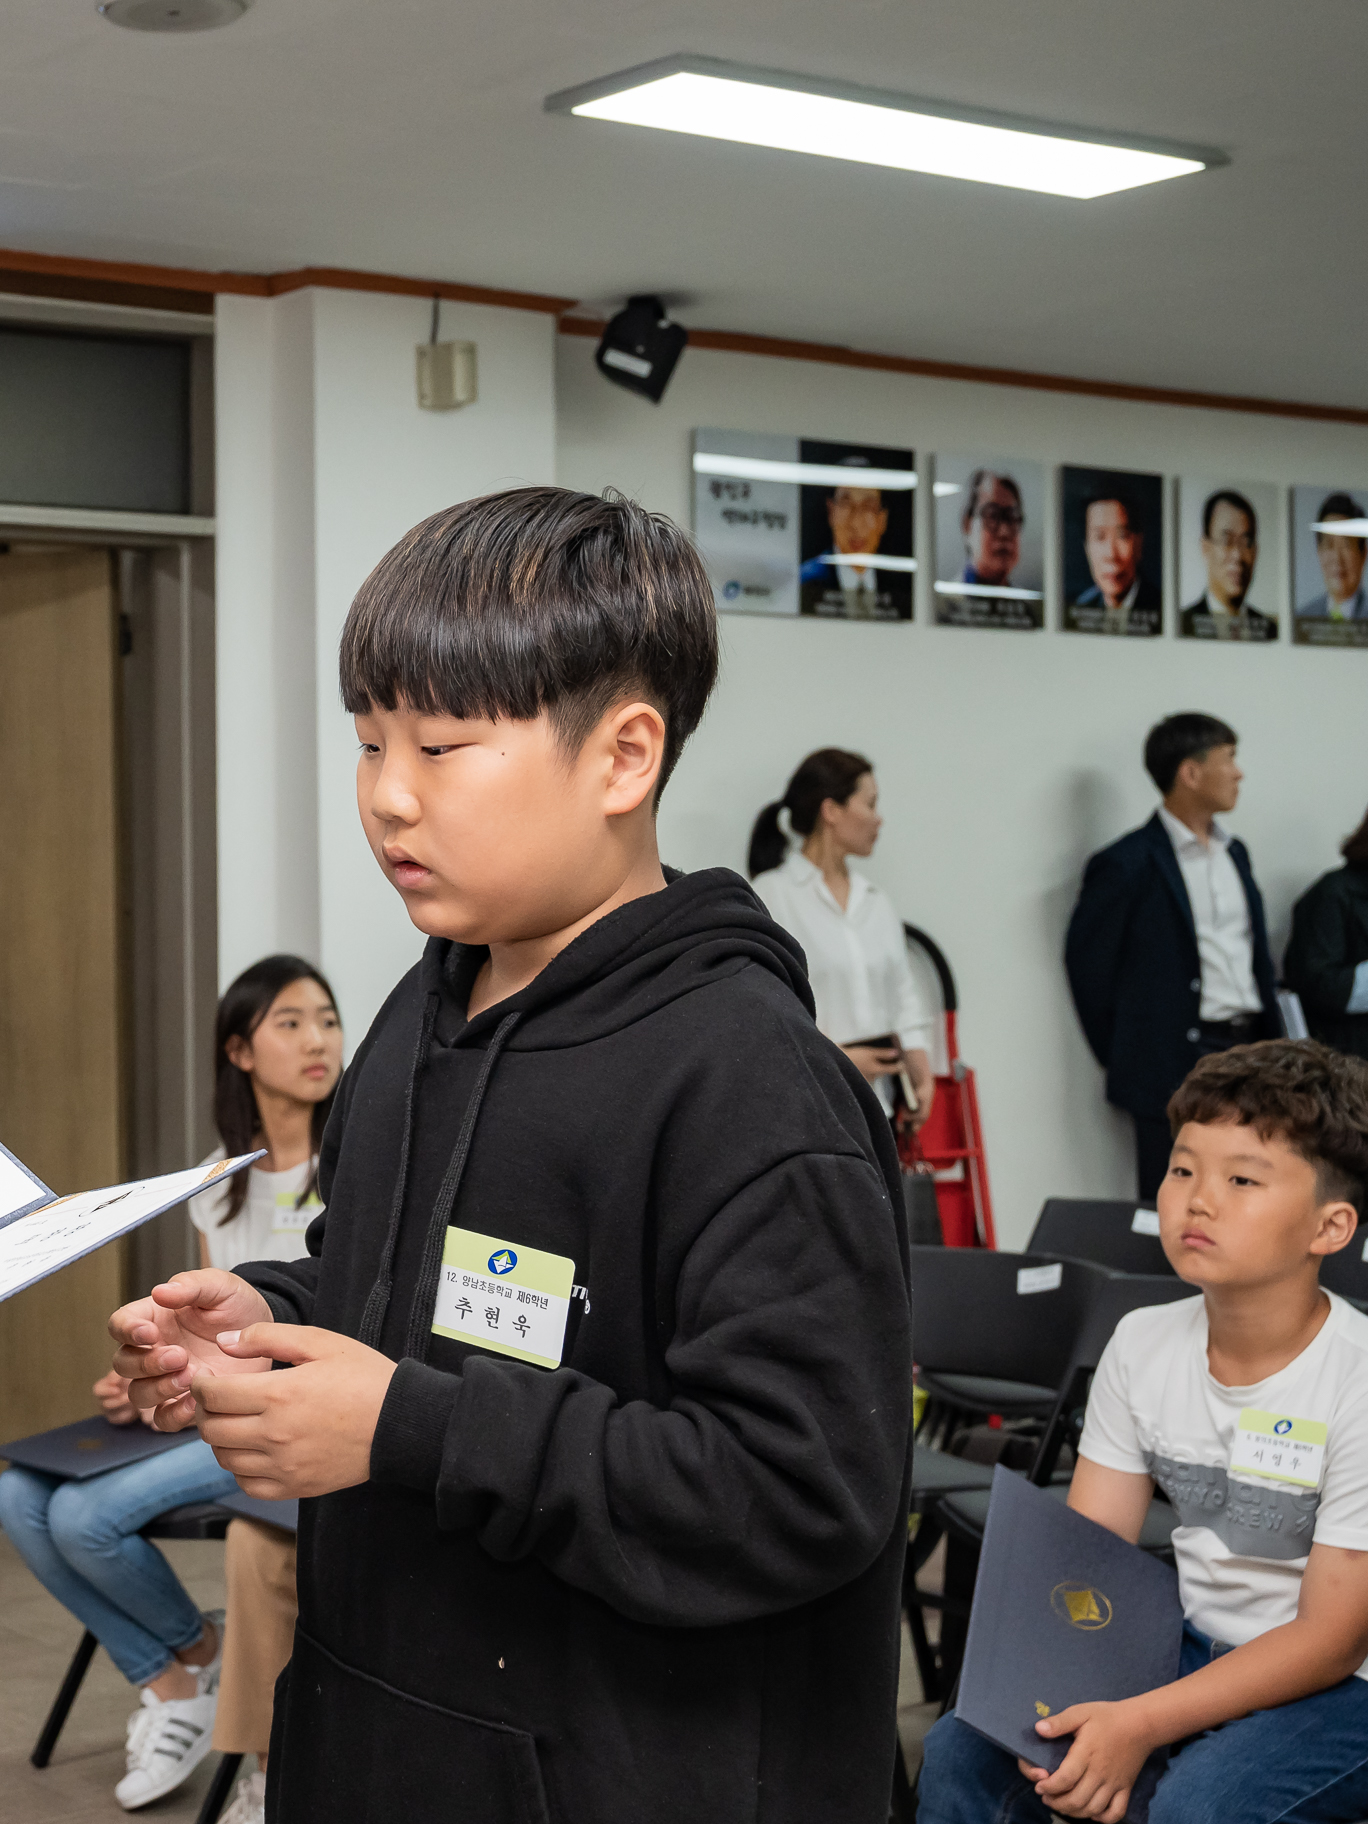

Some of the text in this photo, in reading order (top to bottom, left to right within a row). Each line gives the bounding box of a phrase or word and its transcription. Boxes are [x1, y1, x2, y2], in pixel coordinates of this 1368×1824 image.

[446, 1271, 458, 1283] 12.
[462, 1275, 513, 1299] 양남초등학교
[516, 1290, 549, 1310] 제6학년
